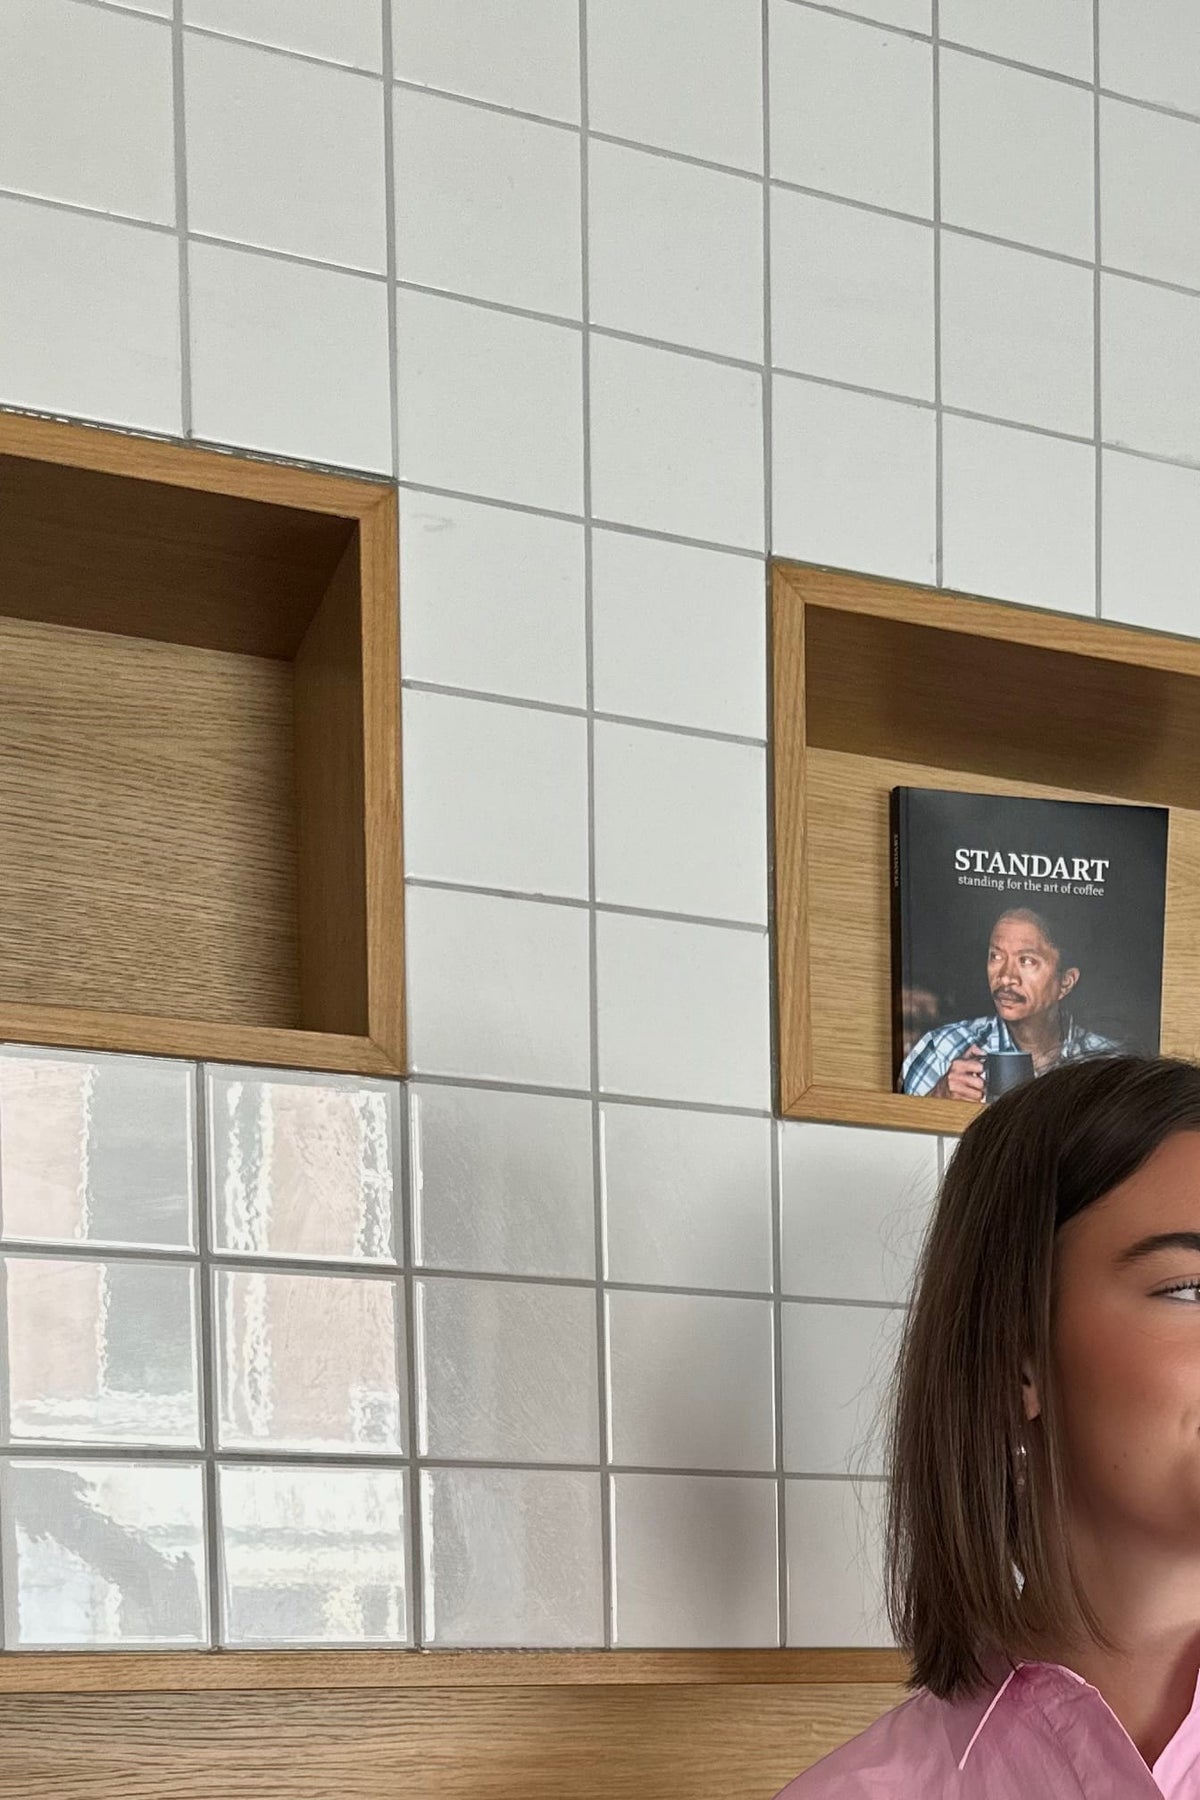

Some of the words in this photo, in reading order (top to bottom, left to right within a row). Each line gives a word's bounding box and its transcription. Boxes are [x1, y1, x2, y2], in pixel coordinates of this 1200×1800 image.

[955, 848, 1110, 882] STANDART
[958, 875, 1004, 891] standing
[1007, 878, 1022, 889] for
[1024, 880, 1041, 891] the
[1043, 882, 1059, 893] art
[1061, 882, 1071, 893] of
[1073, 884, 1105, 896] coffee
